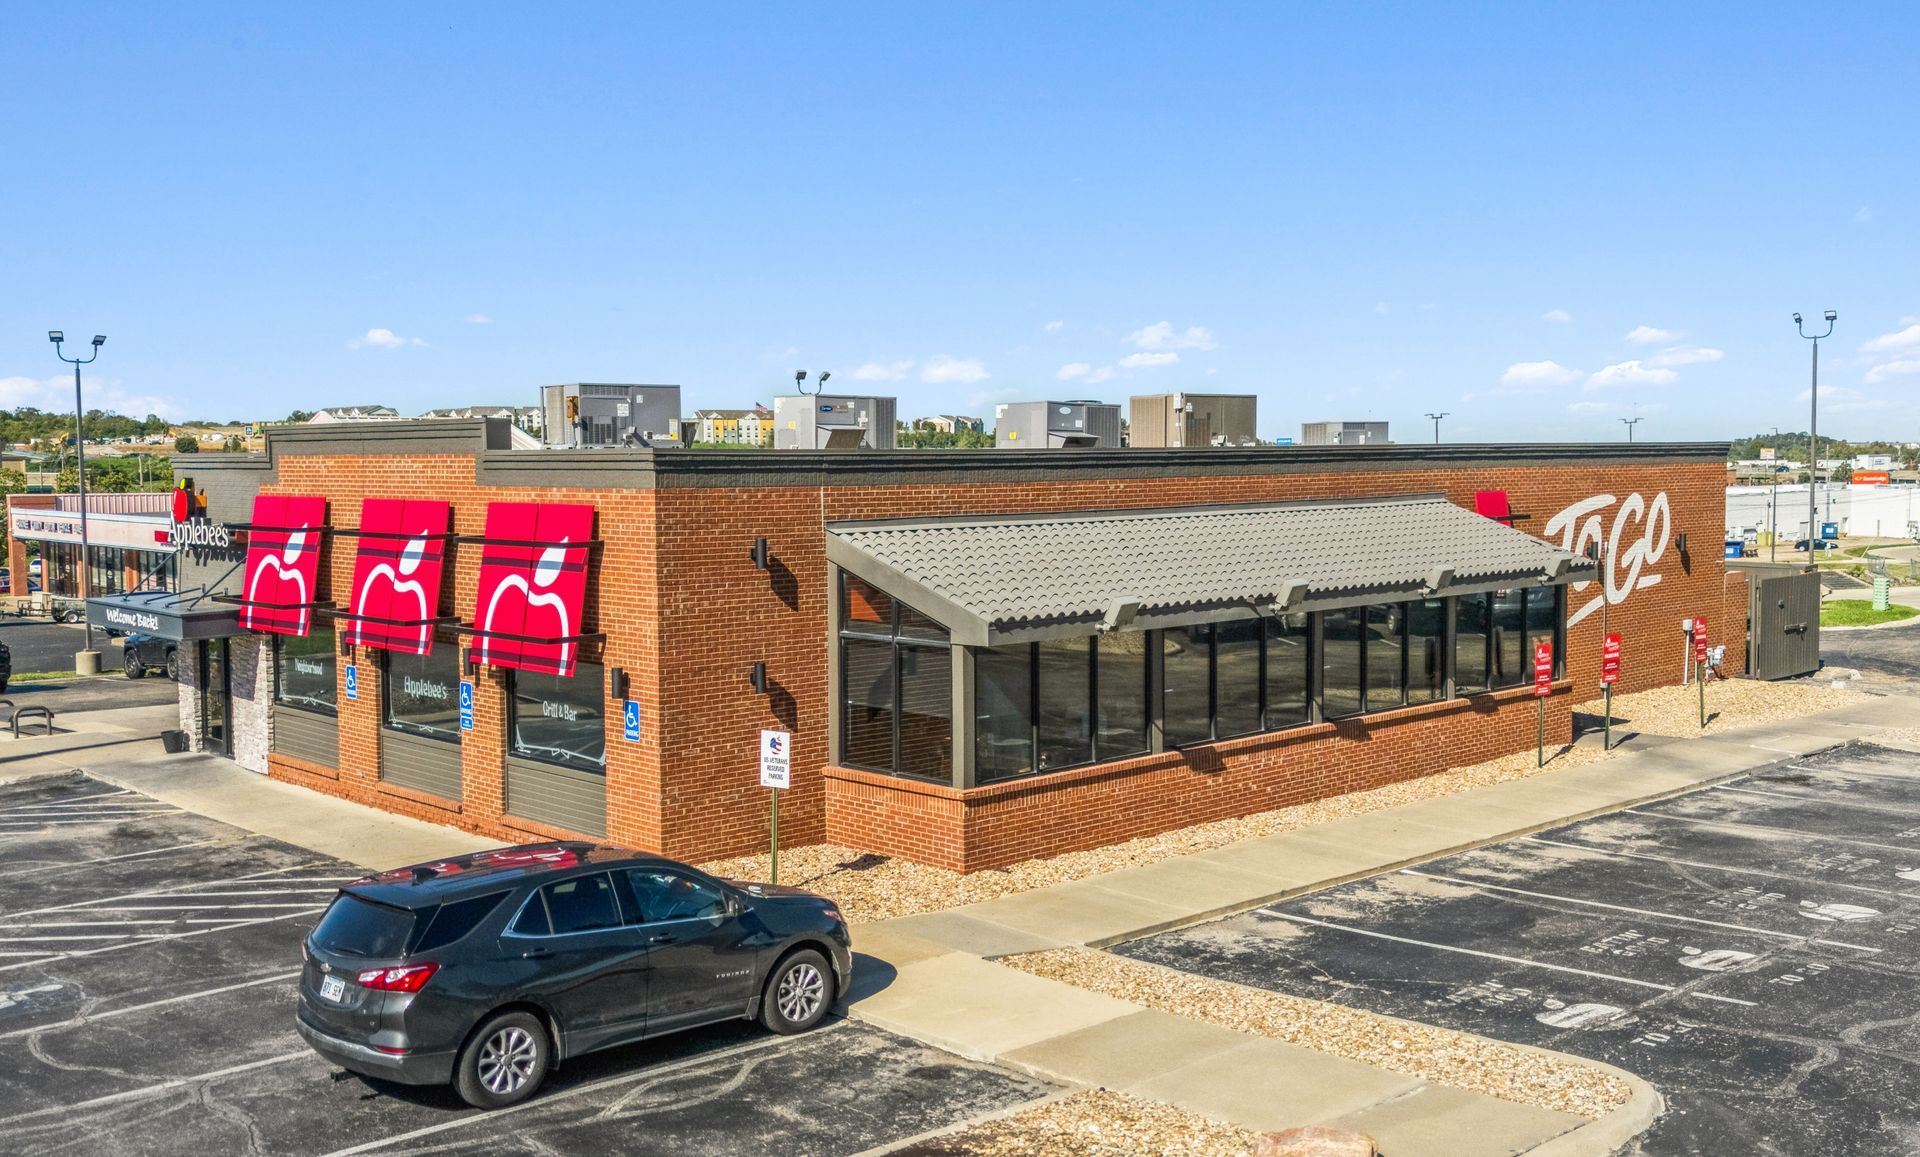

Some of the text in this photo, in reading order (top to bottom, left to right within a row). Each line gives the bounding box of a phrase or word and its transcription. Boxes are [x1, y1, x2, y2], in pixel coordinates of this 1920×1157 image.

[168, 511, 229, 550] Applebee's
[106, 608, 159, 630] Welcome Back!
[404, 675, 448, 699] Applebee's
[542, 700, 577, 721] Grill & Bar
